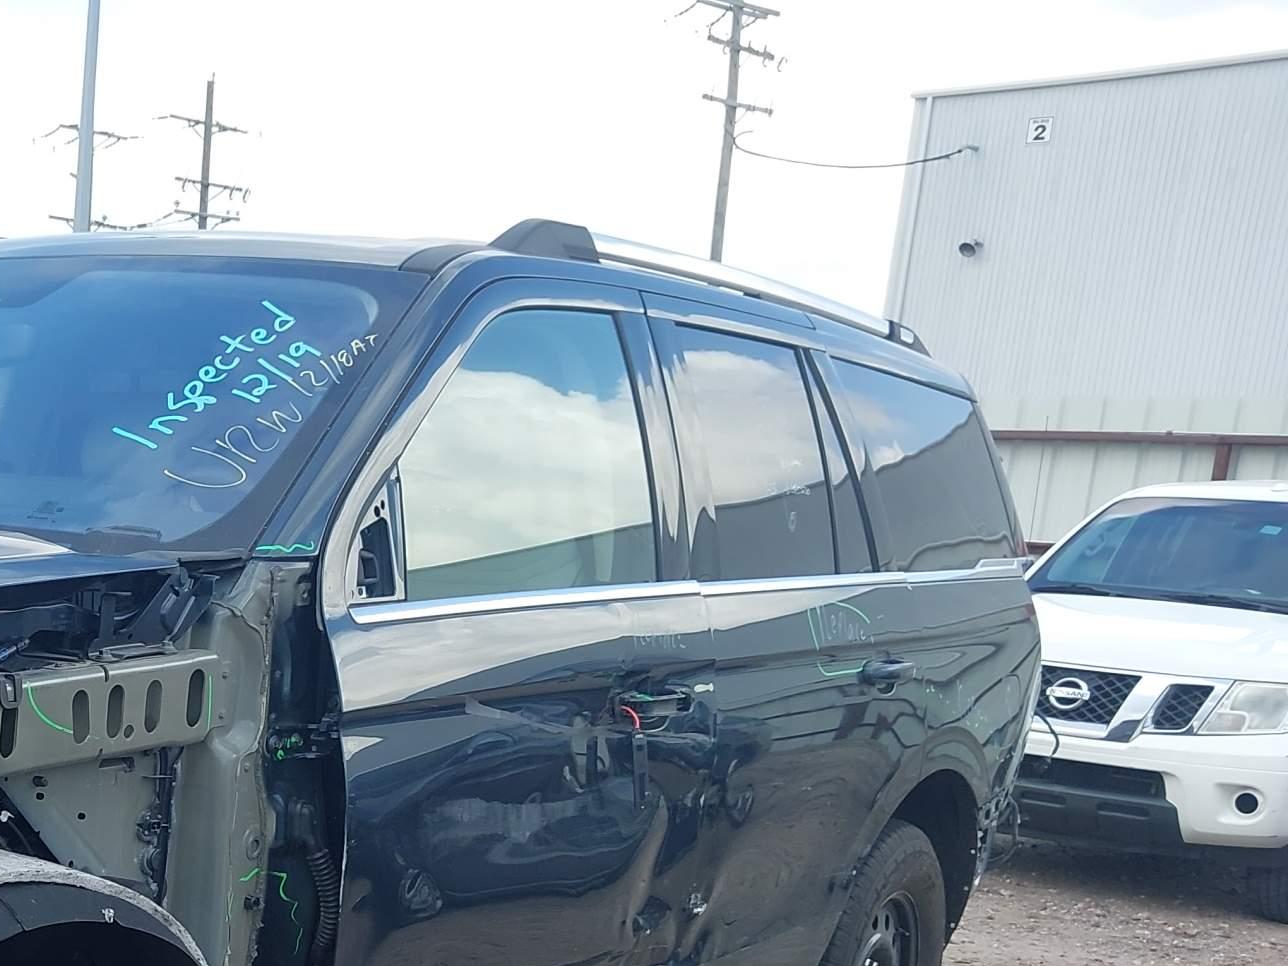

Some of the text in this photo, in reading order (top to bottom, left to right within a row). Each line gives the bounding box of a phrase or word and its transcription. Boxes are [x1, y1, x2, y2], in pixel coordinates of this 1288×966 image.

[1032, 124, 1047, 141] 2
[111, 299, 296, 450] Inspected
[231, 340, 322, 404] 12/19
